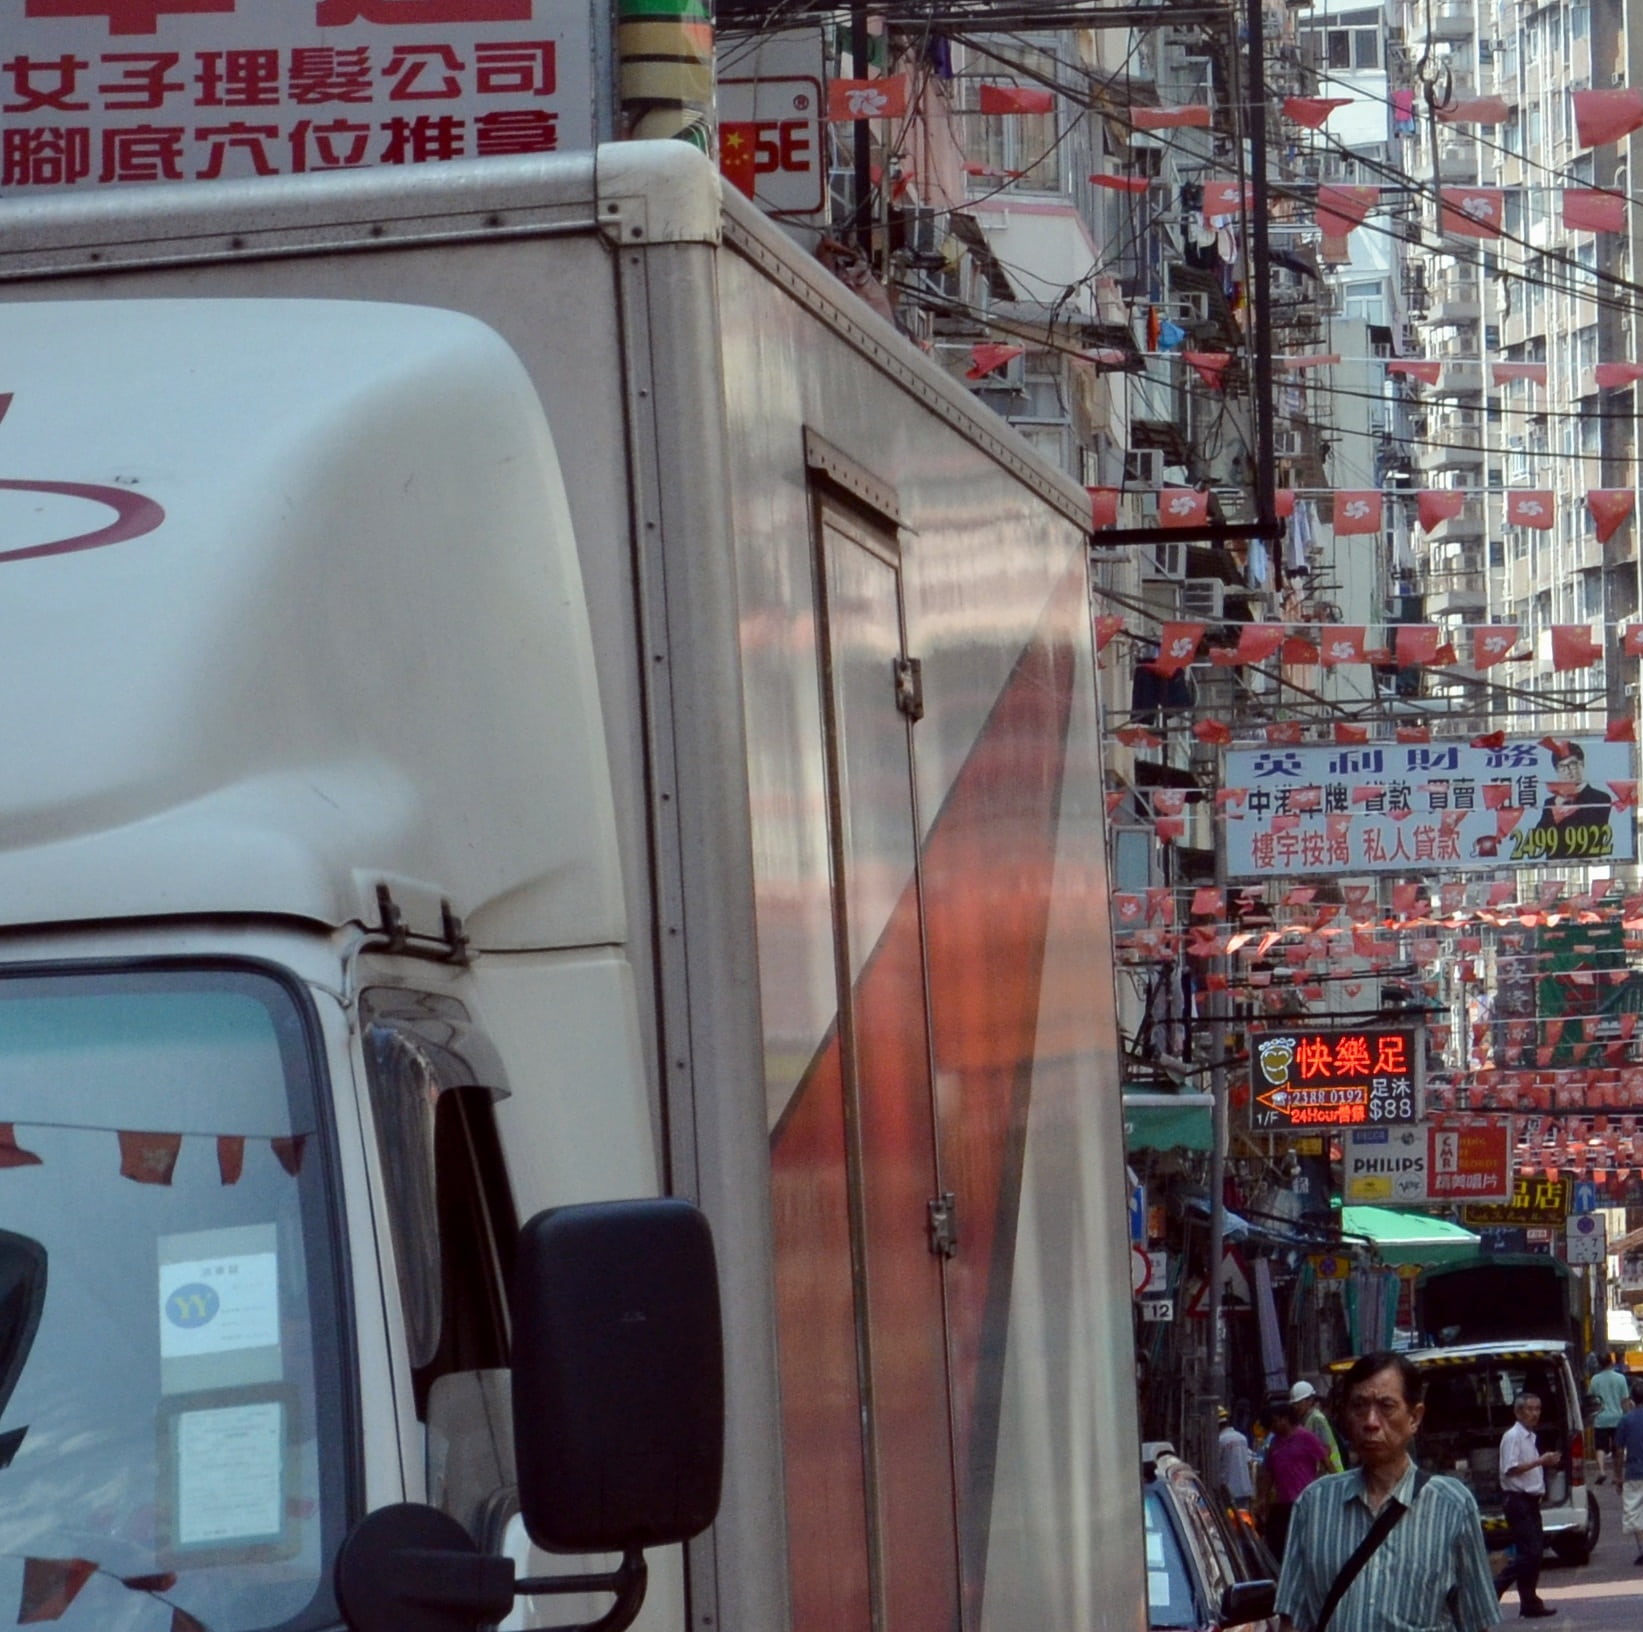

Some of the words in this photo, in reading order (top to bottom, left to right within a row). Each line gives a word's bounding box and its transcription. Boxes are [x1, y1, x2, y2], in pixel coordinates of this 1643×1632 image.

[2, 39, 558, 114] 女子理髮公司
[1510, 830, 1557, 859] 2499
[1565, 825, 1613, 856] 9922
[1296, 1036, 1407, 1079] 快樂足
[1369, 1099, 1412, 1121] $88
[1354, 1157, 1424, 1174] PHILIPS
